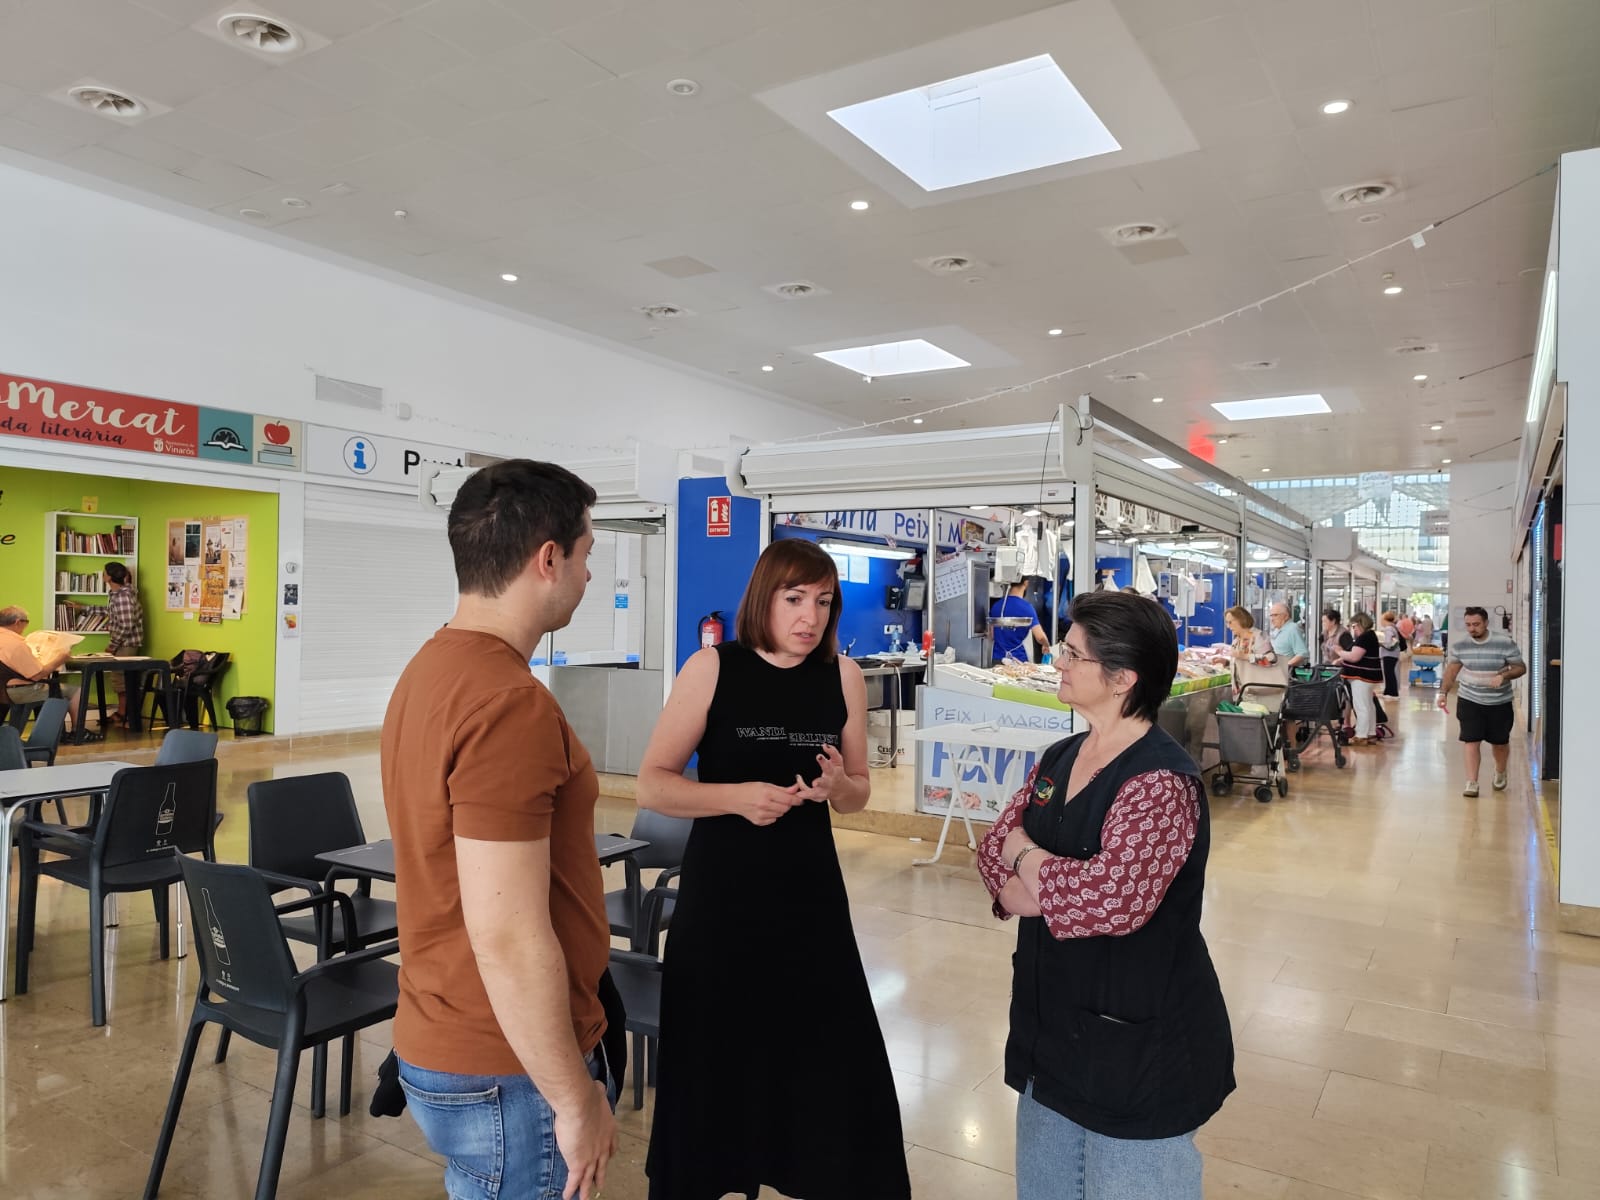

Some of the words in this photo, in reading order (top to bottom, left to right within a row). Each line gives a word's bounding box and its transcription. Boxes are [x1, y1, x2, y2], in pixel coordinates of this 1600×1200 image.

[0, 381, 185, 436] Mercat
[41, 421, 126, 446] literària
[165, 444, 195, 456] Vinaròs
[935, 707, 971, 721] PEIX
